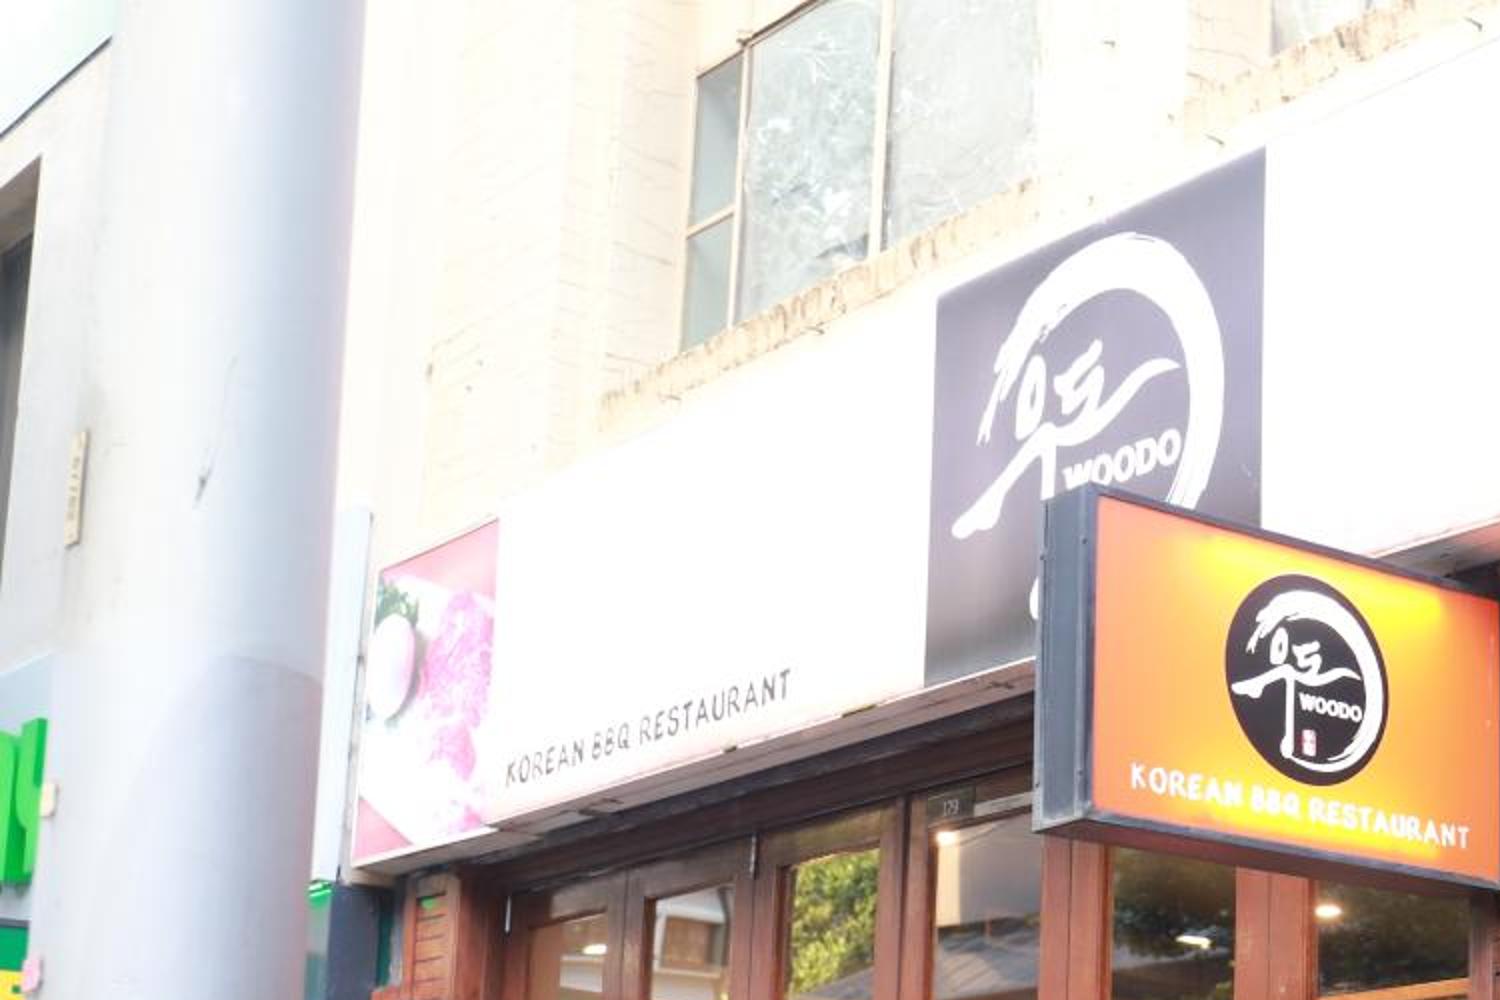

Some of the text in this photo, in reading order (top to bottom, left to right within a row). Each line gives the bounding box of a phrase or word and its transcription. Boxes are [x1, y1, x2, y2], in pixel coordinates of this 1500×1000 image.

[1062, 428, 1182, 489] WOODO
[505, 668, 790, 787] KOREAN BBQ RESTAURANT
[1299, 691, 1363, 723] WOODO
[1130, 762, 1471, 849] KOREAN BBQ RESTAURANT
